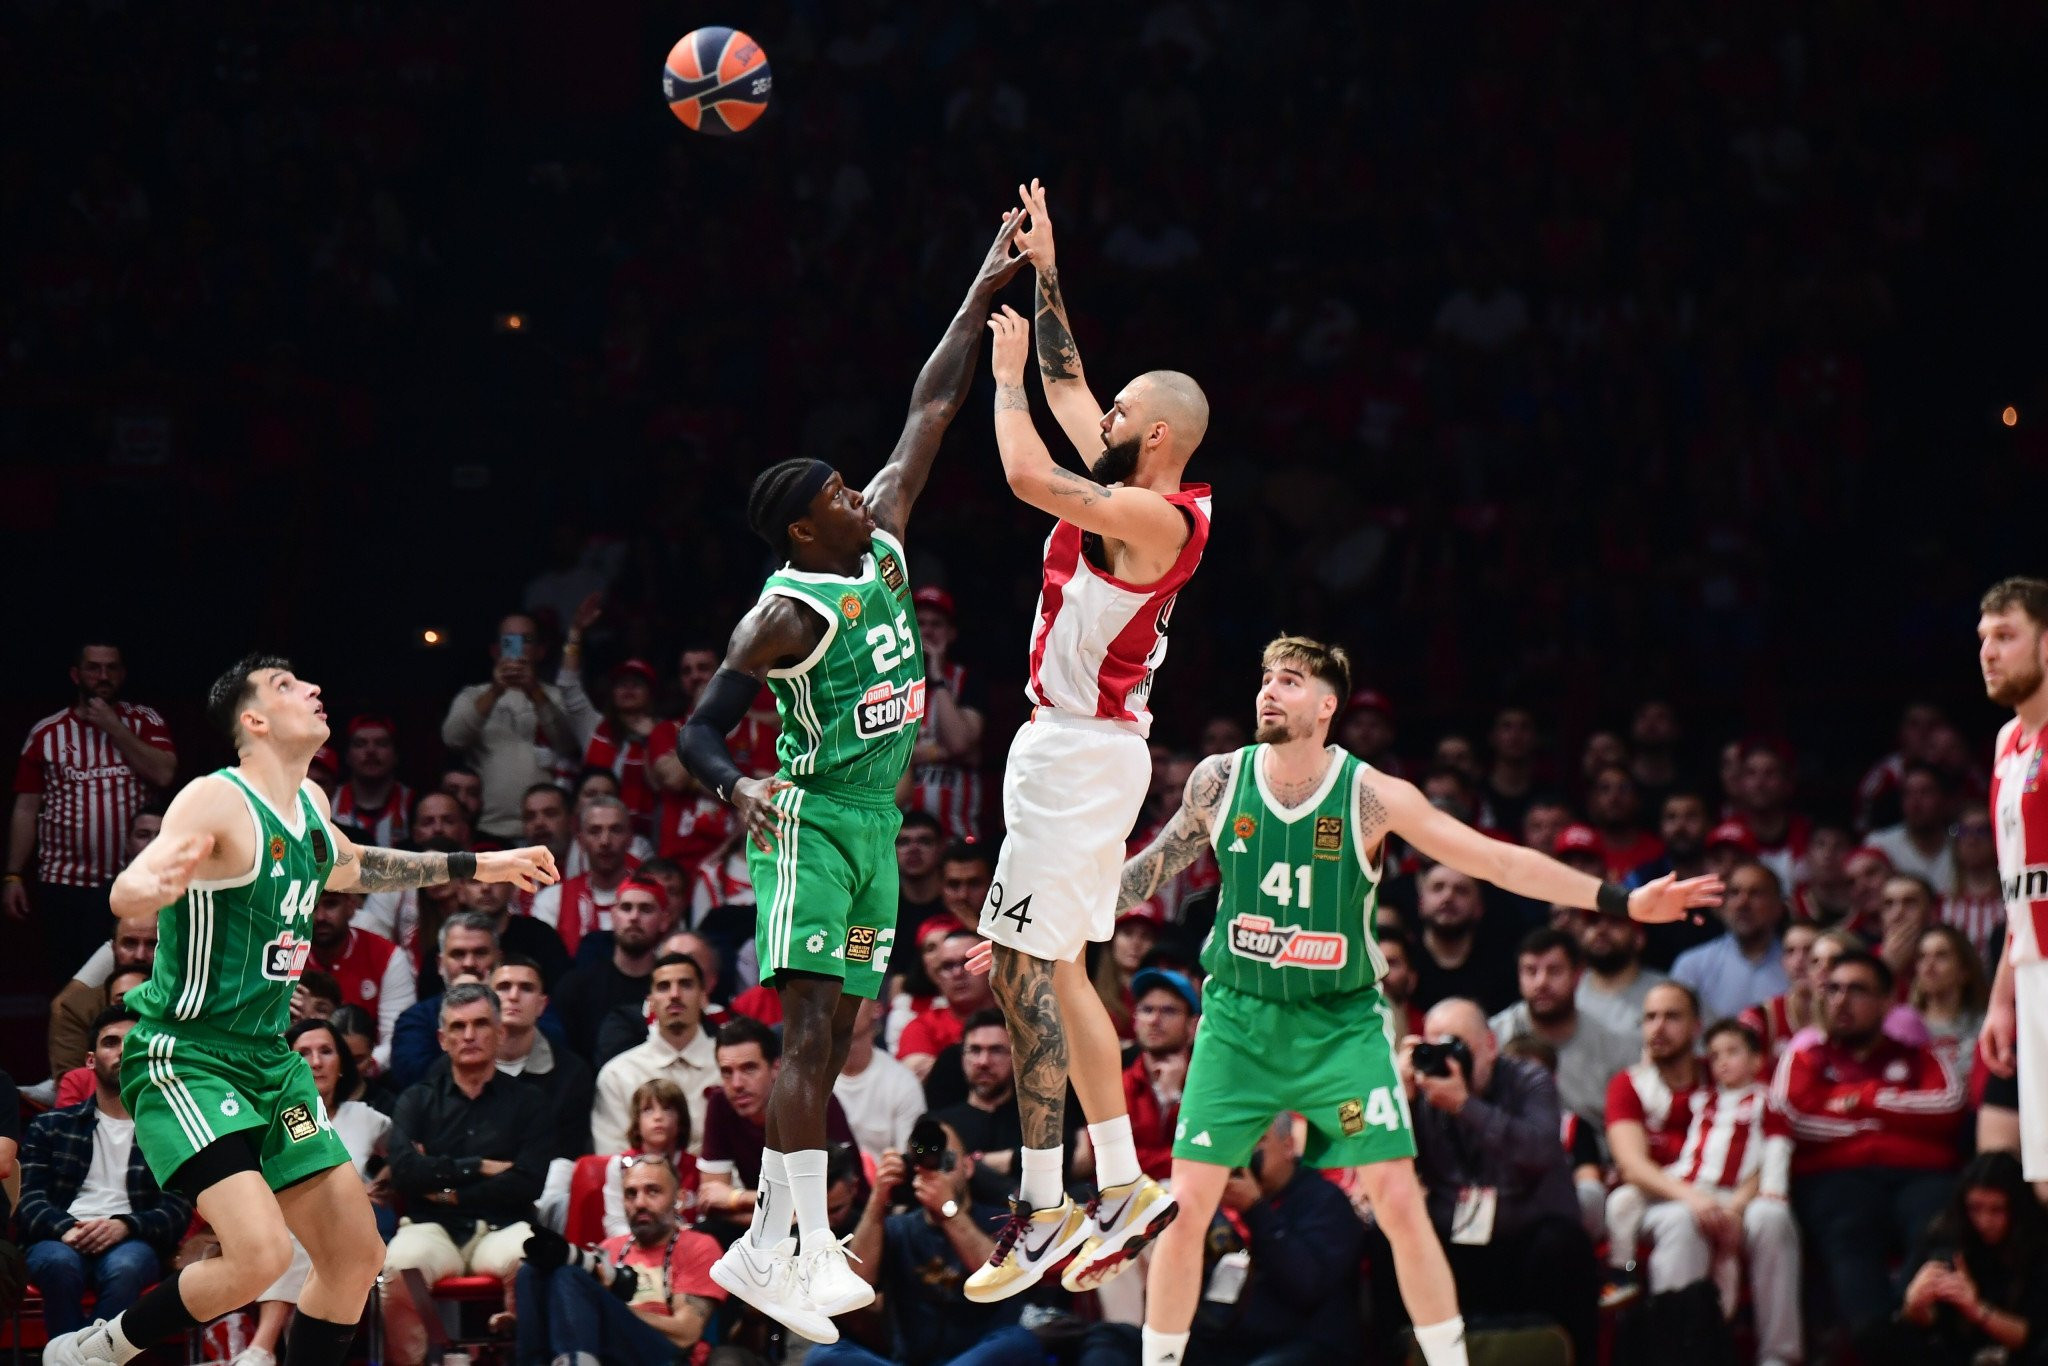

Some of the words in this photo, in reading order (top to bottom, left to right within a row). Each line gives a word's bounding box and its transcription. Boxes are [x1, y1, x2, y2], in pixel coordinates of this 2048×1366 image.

[866, 610, 915, 674] 25
[868, 687, 890, 703] pame
[1318, 818, 1340, 834] 25
[280, 879, 320, 925] 44
[991, 881, 1033, 934] 94
[1260, 861, 1312, 909] 41
[850, 929, 874, 944] 25
[284, 1107, 308, 1127] 25
[1364, 1085, 1412, 1132] 41
